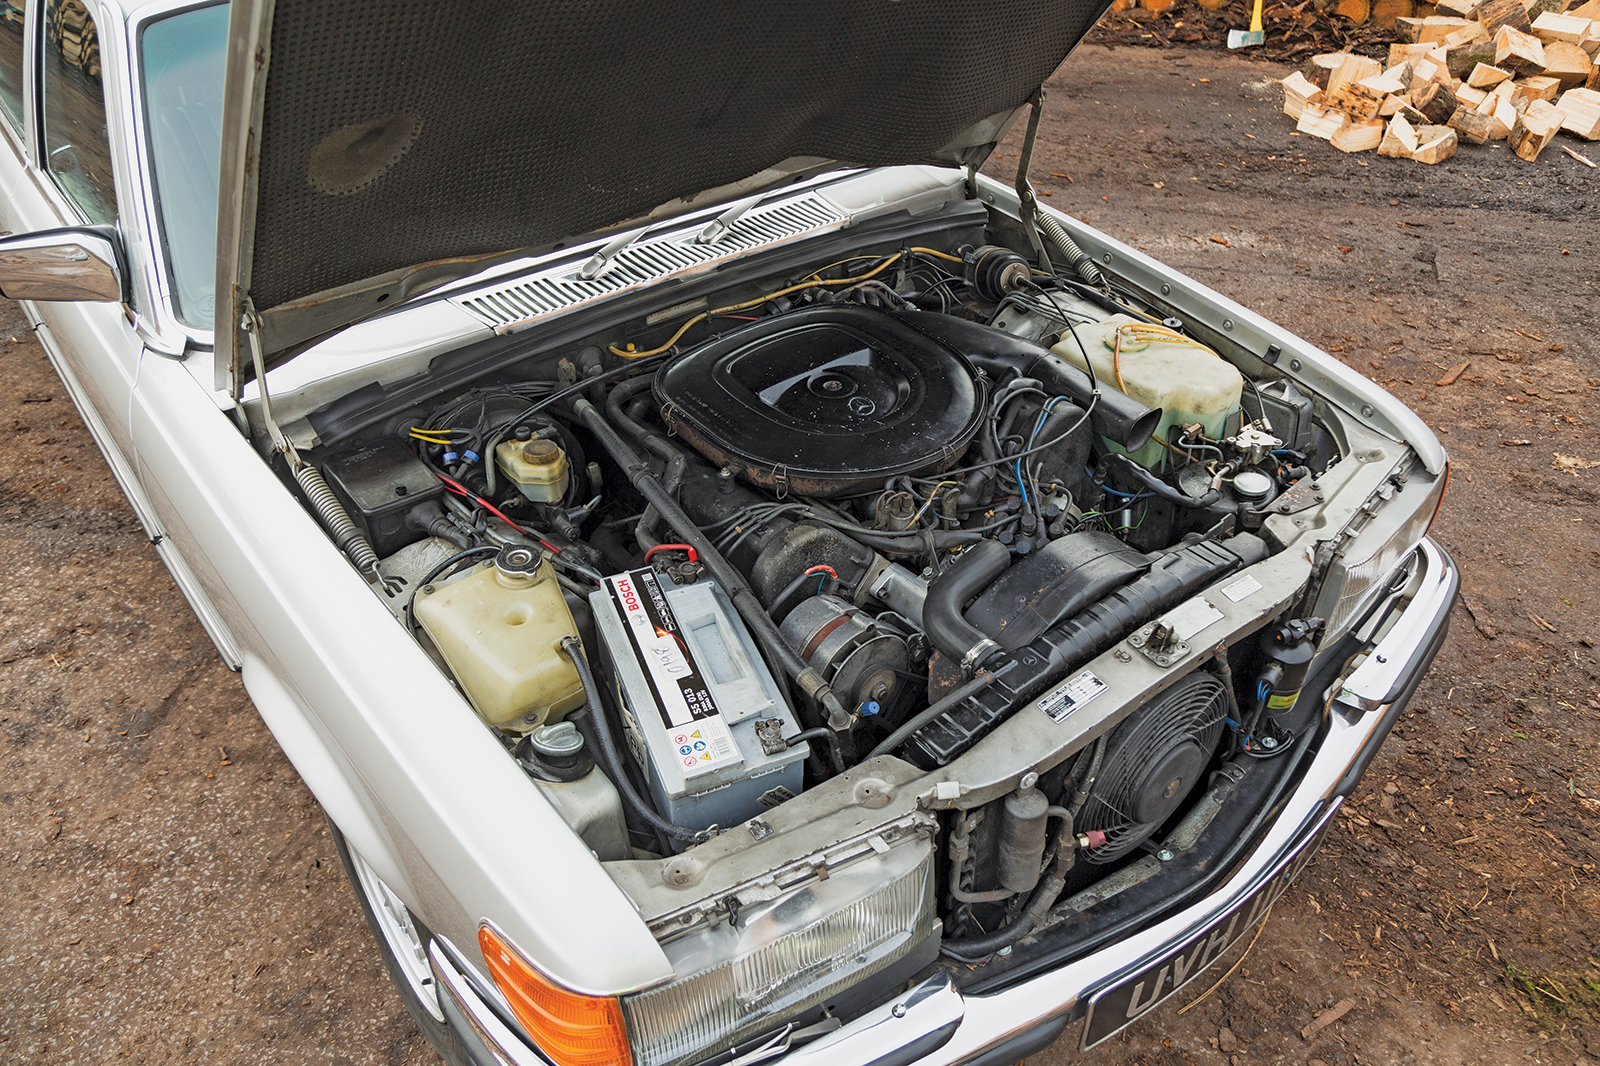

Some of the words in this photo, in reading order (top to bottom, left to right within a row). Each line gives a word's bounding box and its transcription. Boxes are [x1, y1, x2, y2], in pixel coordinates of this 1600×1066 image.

[617, 579, 640, 611] BOSCH
[683, 688, 697, 702] 013
[1126, 912, 1241, 1019] UVH
